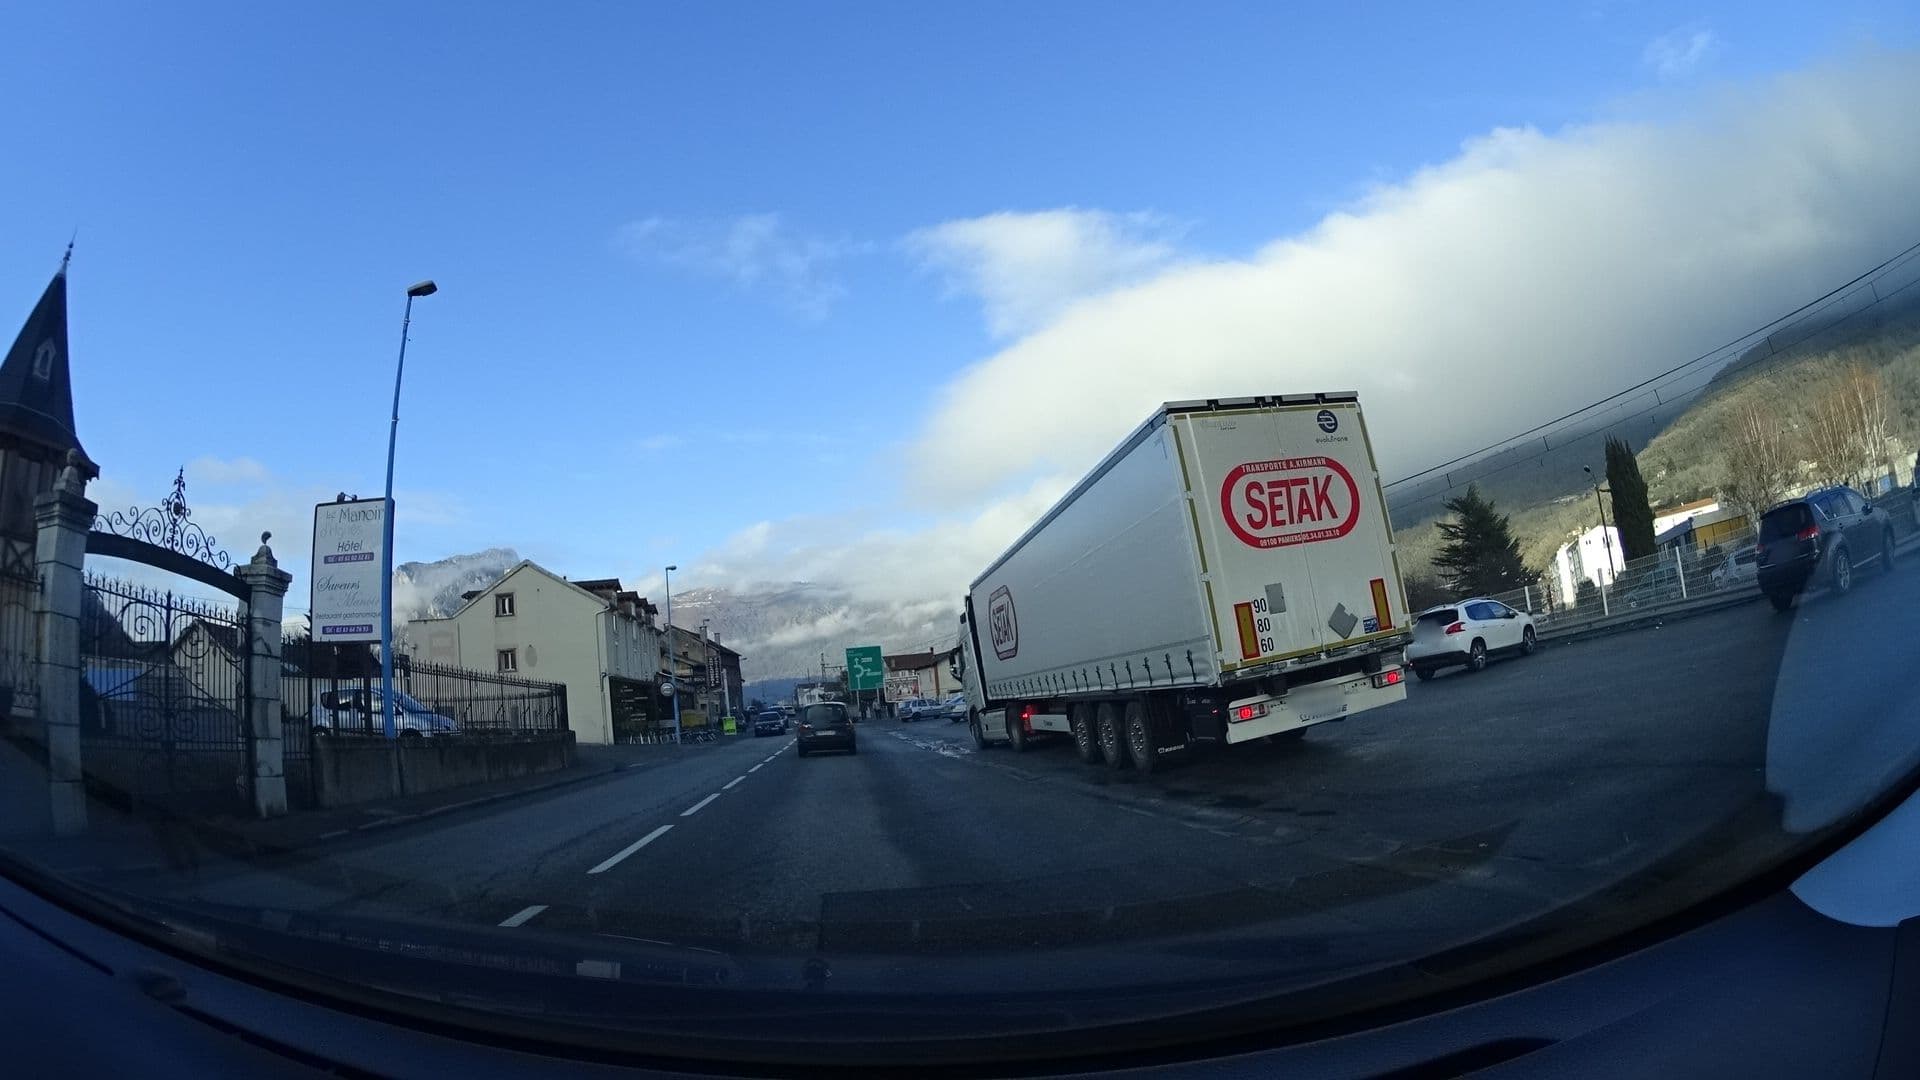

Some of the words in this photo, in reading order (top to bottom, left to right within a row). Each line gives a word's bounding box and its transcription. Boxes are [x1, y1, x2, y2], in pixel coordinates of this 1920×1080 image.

[1245, 474, 1339, 530] SETAK
[338, 504, 385, 523] Manoir
[336, 539, 363, 552] Hôtel
[315, 575, 361, 593] Saveurs
[1252, 597, 1268, 614] 90
[992, 599, 1015, 647] SETAK
[1256, 616, 1271, 633] 80
[1260, 637, 1275, 653] 60
